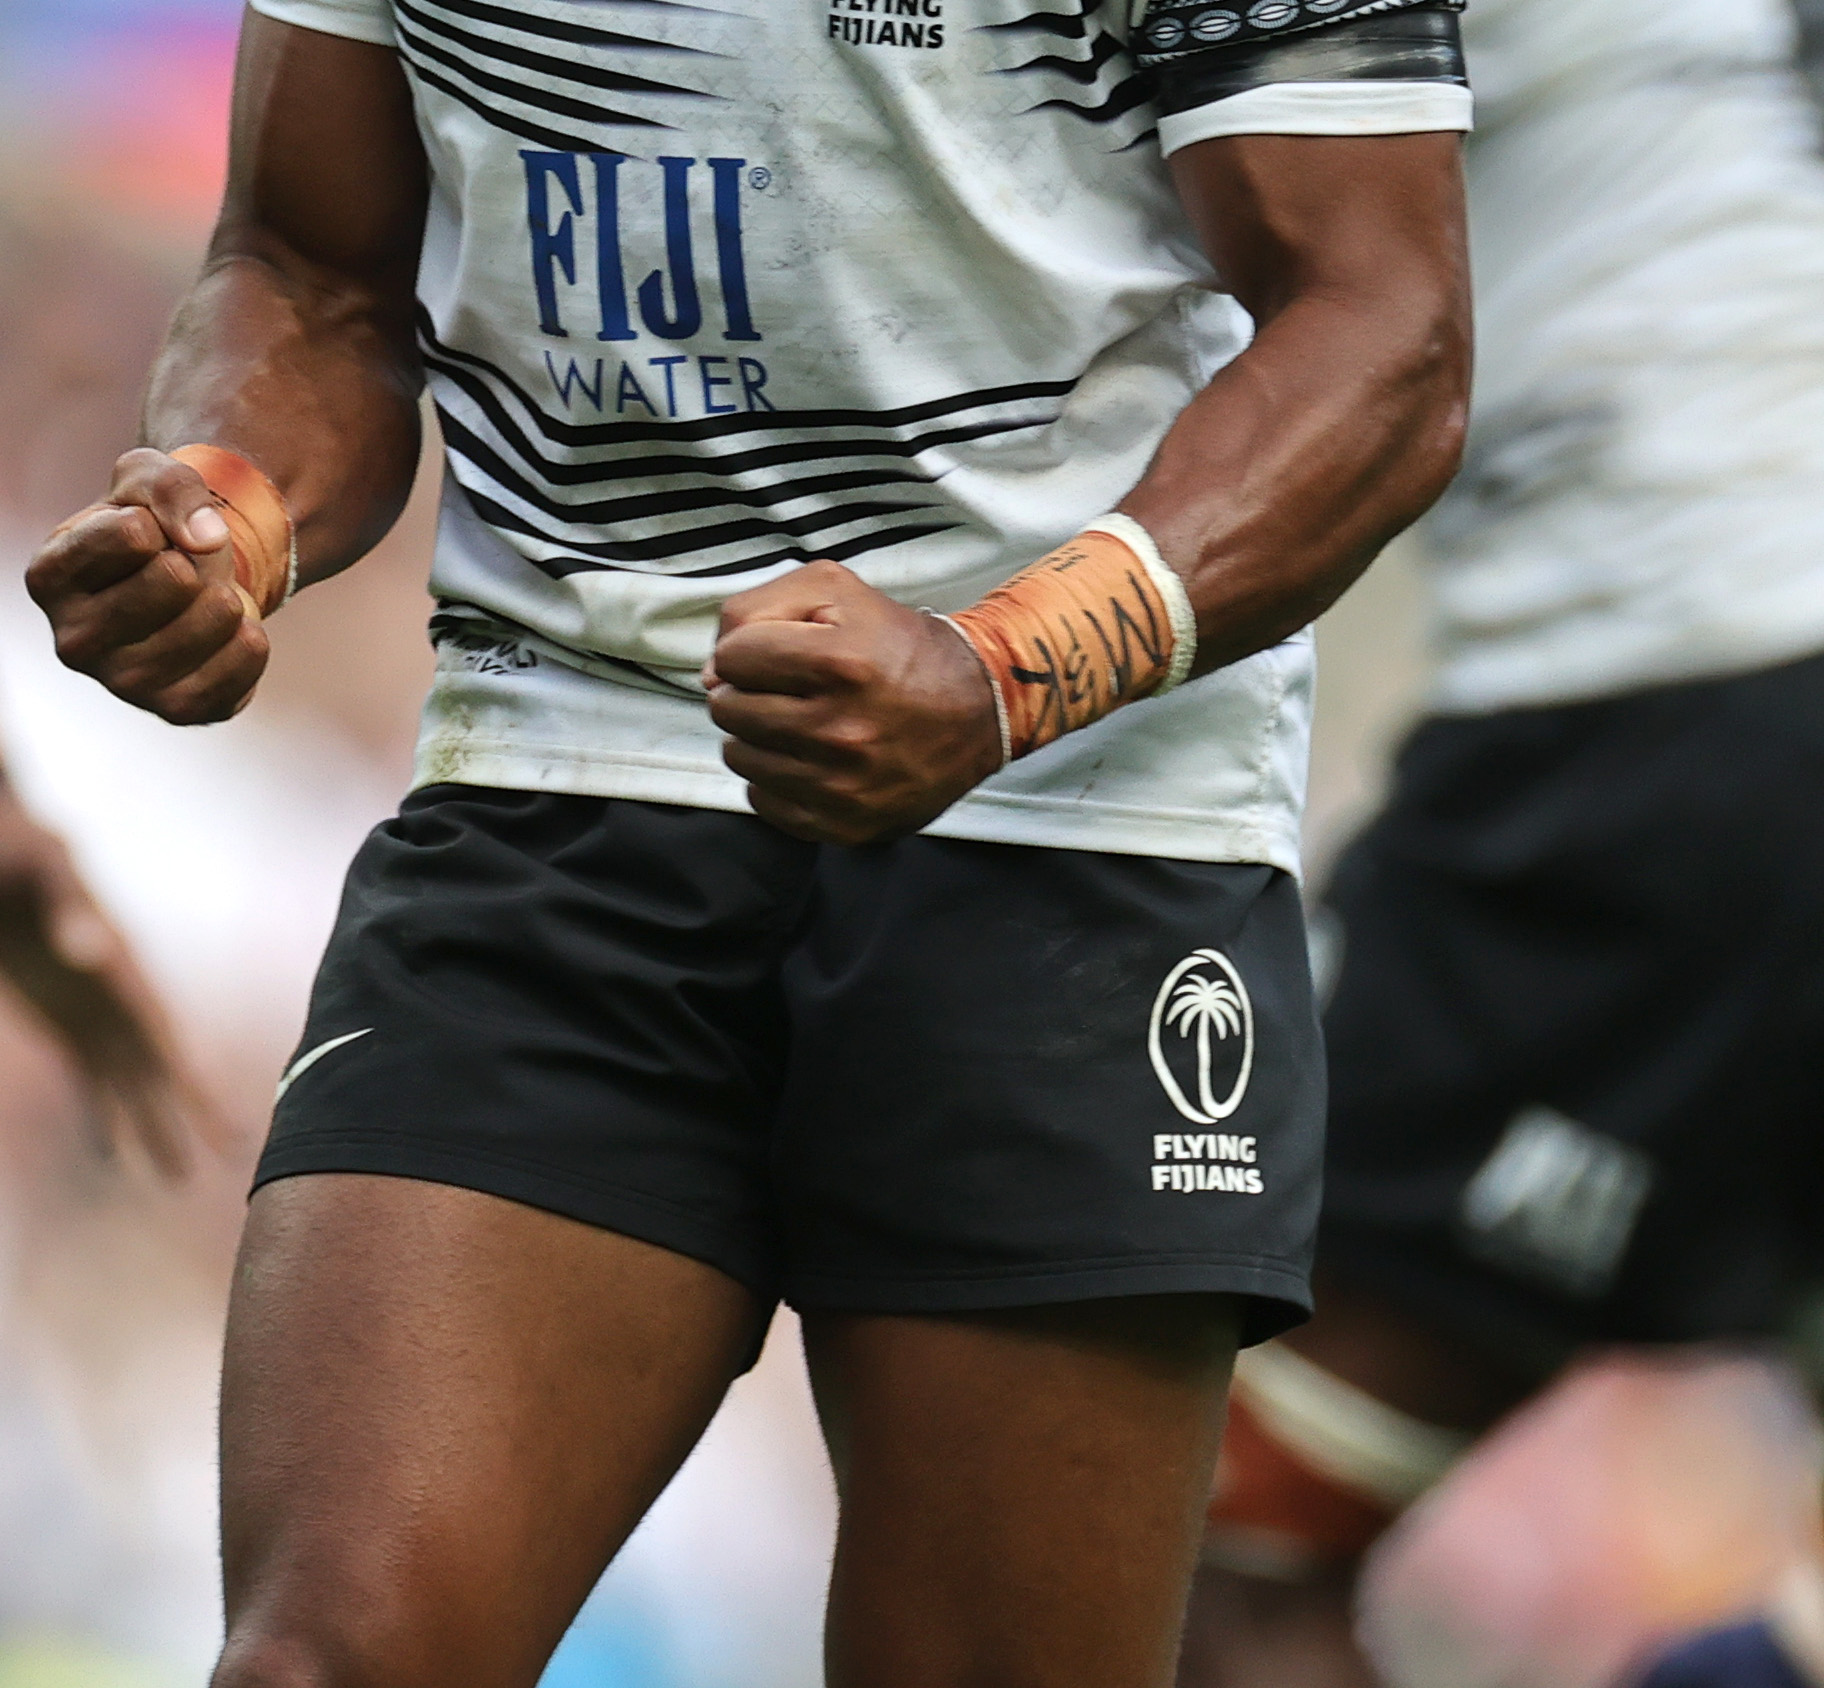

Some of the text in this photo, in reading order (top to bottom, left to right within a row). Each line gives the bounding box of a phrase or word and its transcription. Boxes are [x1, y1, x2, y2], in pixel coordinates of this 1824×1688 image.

[828, 13, 945, 49] FIJIANS
[543, 349, 777, 418] WATER
[1152, 1133, 1258, 1164] FLYING
[1150, 1164, 1265, 1195] FIJIANS
